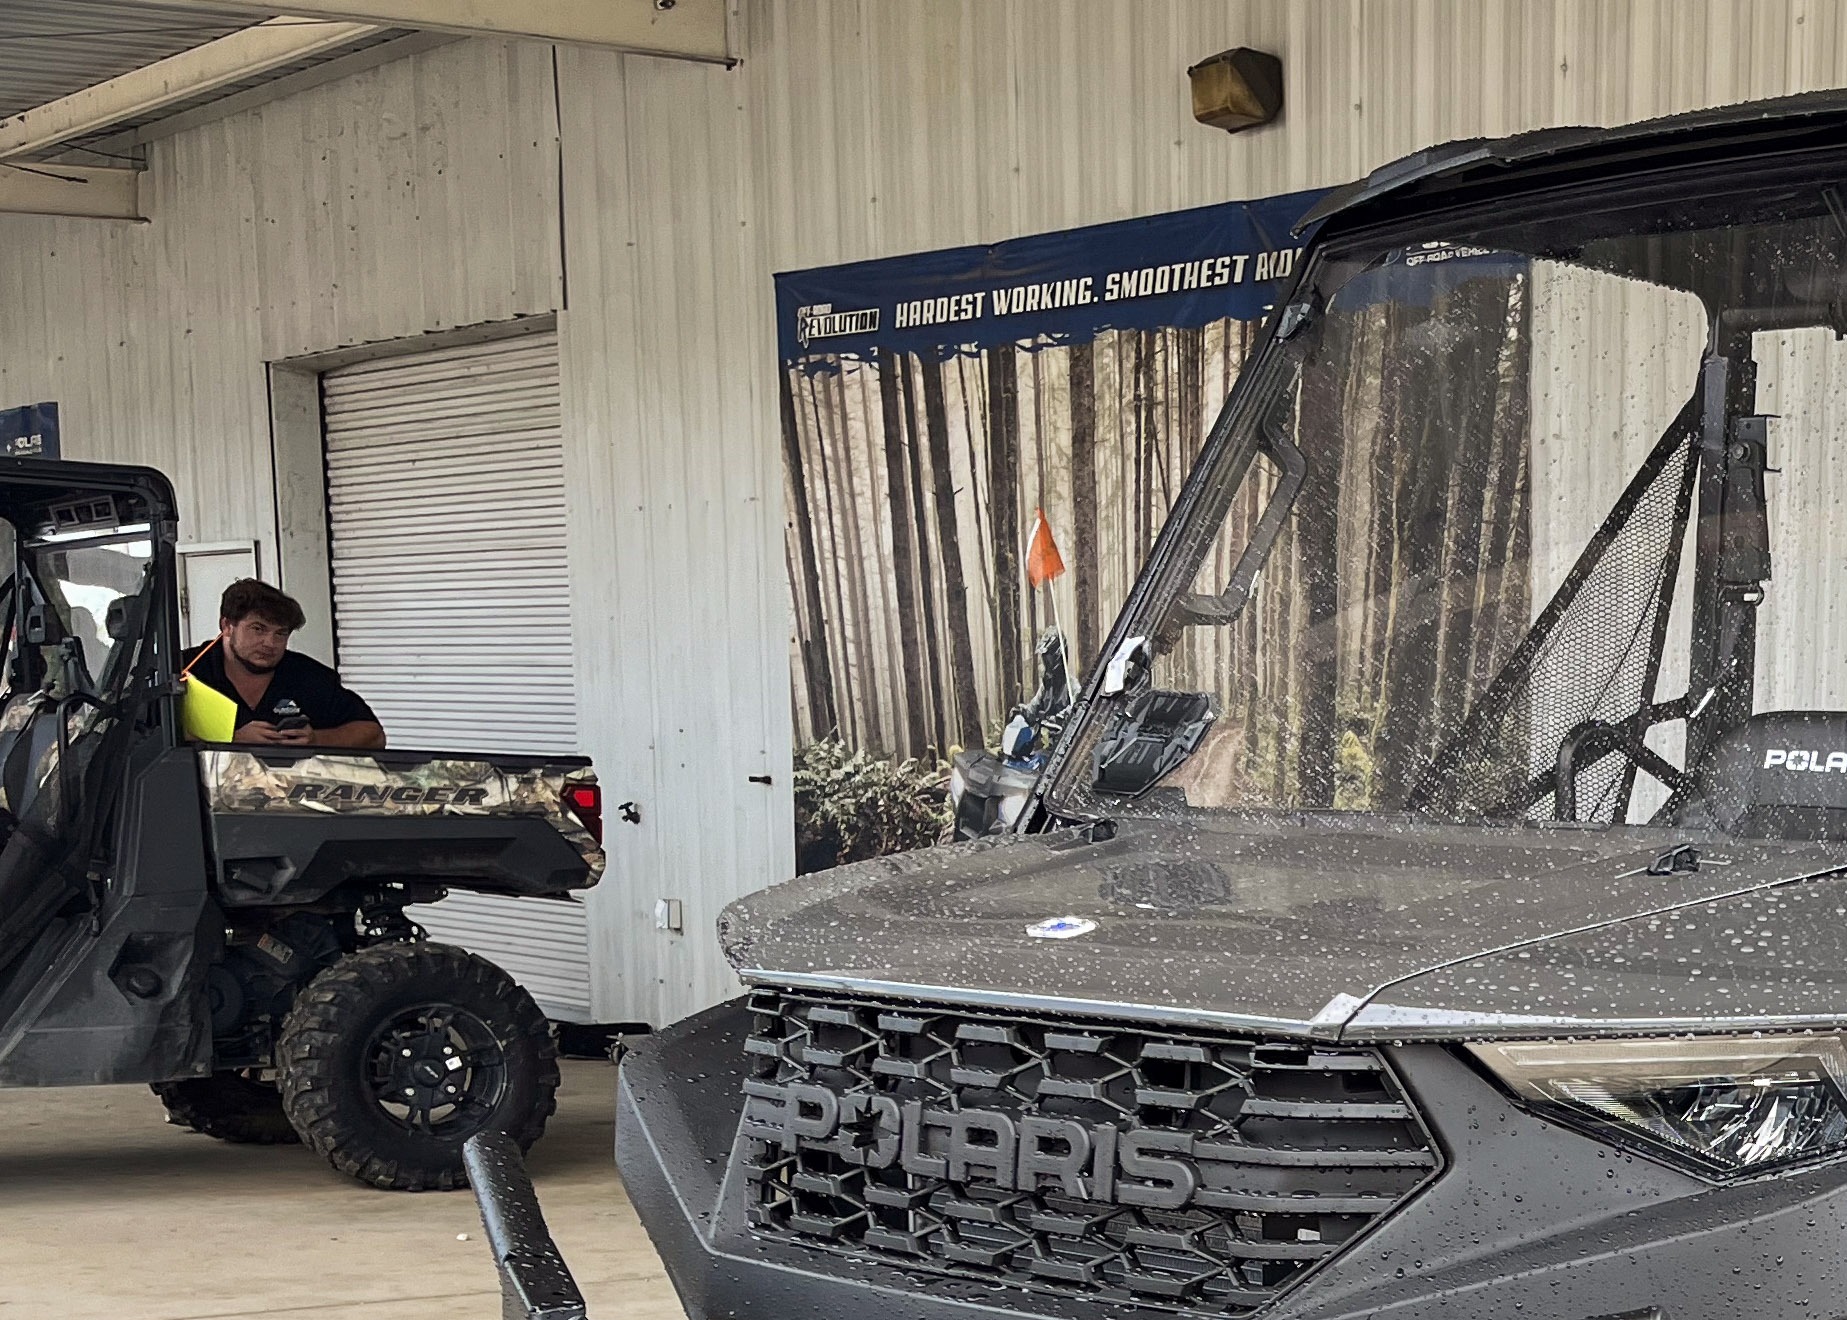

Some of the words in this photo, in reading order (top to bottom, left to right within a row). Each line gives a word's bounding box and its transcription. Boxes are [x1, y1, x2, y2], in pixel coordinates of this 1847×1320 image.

[894, 290, 985, 329] HARDEST
[992, 275, 1099, 316] WORKING.
[1104, 254, 1250, 302] SMOOTHEST
[798, 308, 880, 349] REVOLUTION
[285, 782, 490, 806] RANGER
[780, 1081, 1202, 1211] POLARIS
